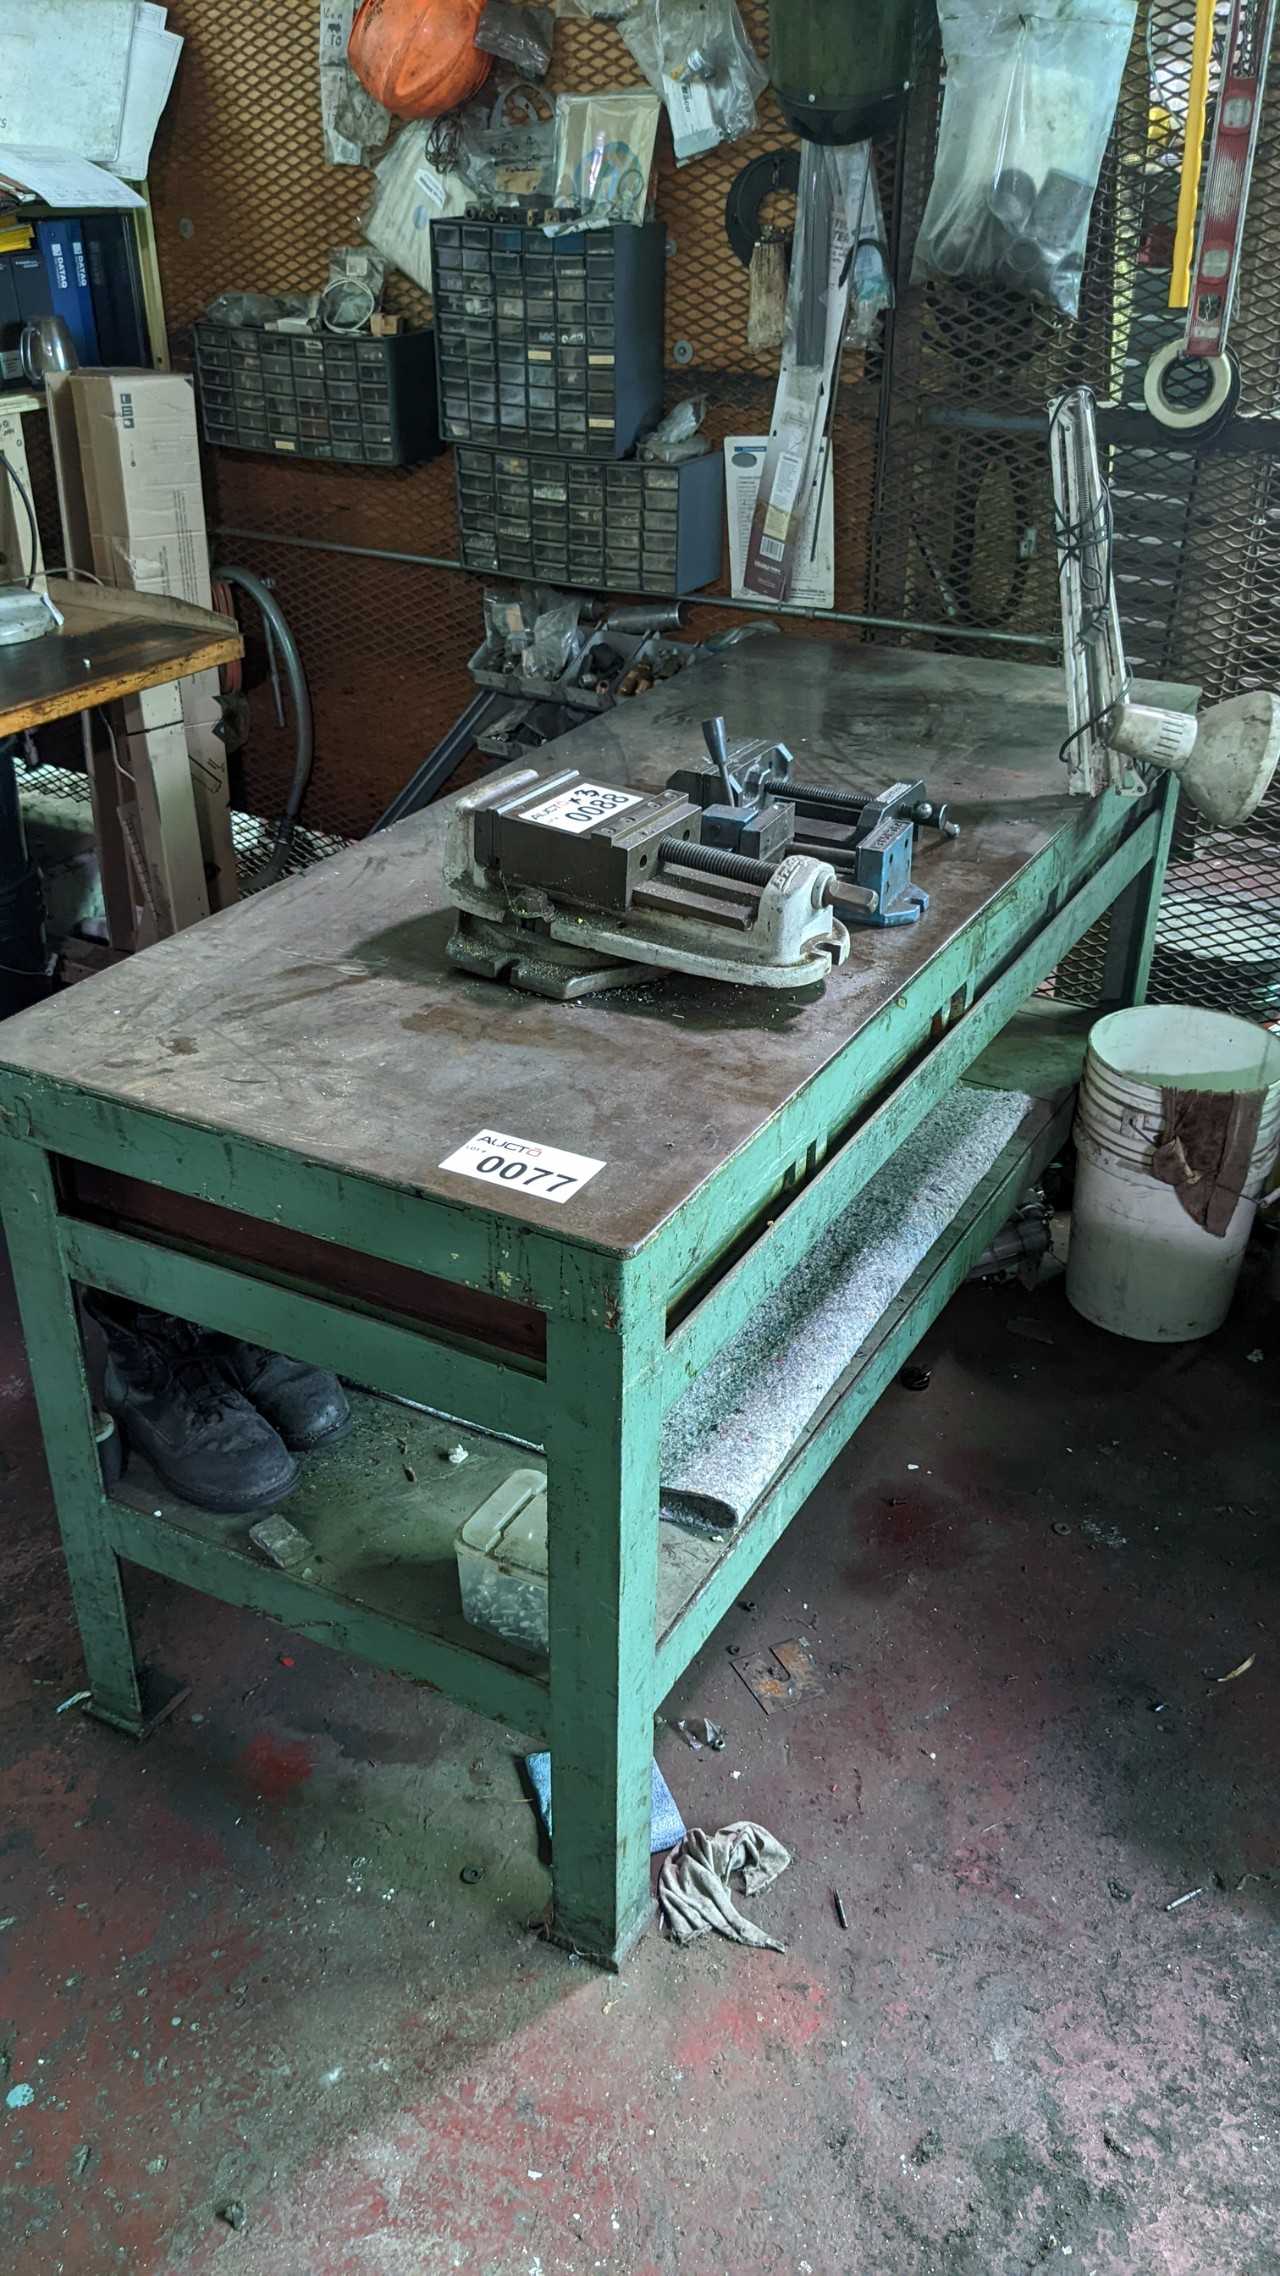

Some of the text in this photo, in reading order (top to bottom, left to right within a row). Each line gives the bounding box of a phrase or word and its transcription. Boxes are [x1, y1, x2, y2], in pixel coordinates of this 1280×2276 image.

[57, 256, 68, 289] DATAQ
[76, 255, 87, 287] DATAQ
[565, 793, 629, 822] 0088
[476, 1155, 578, 1192] 0077
